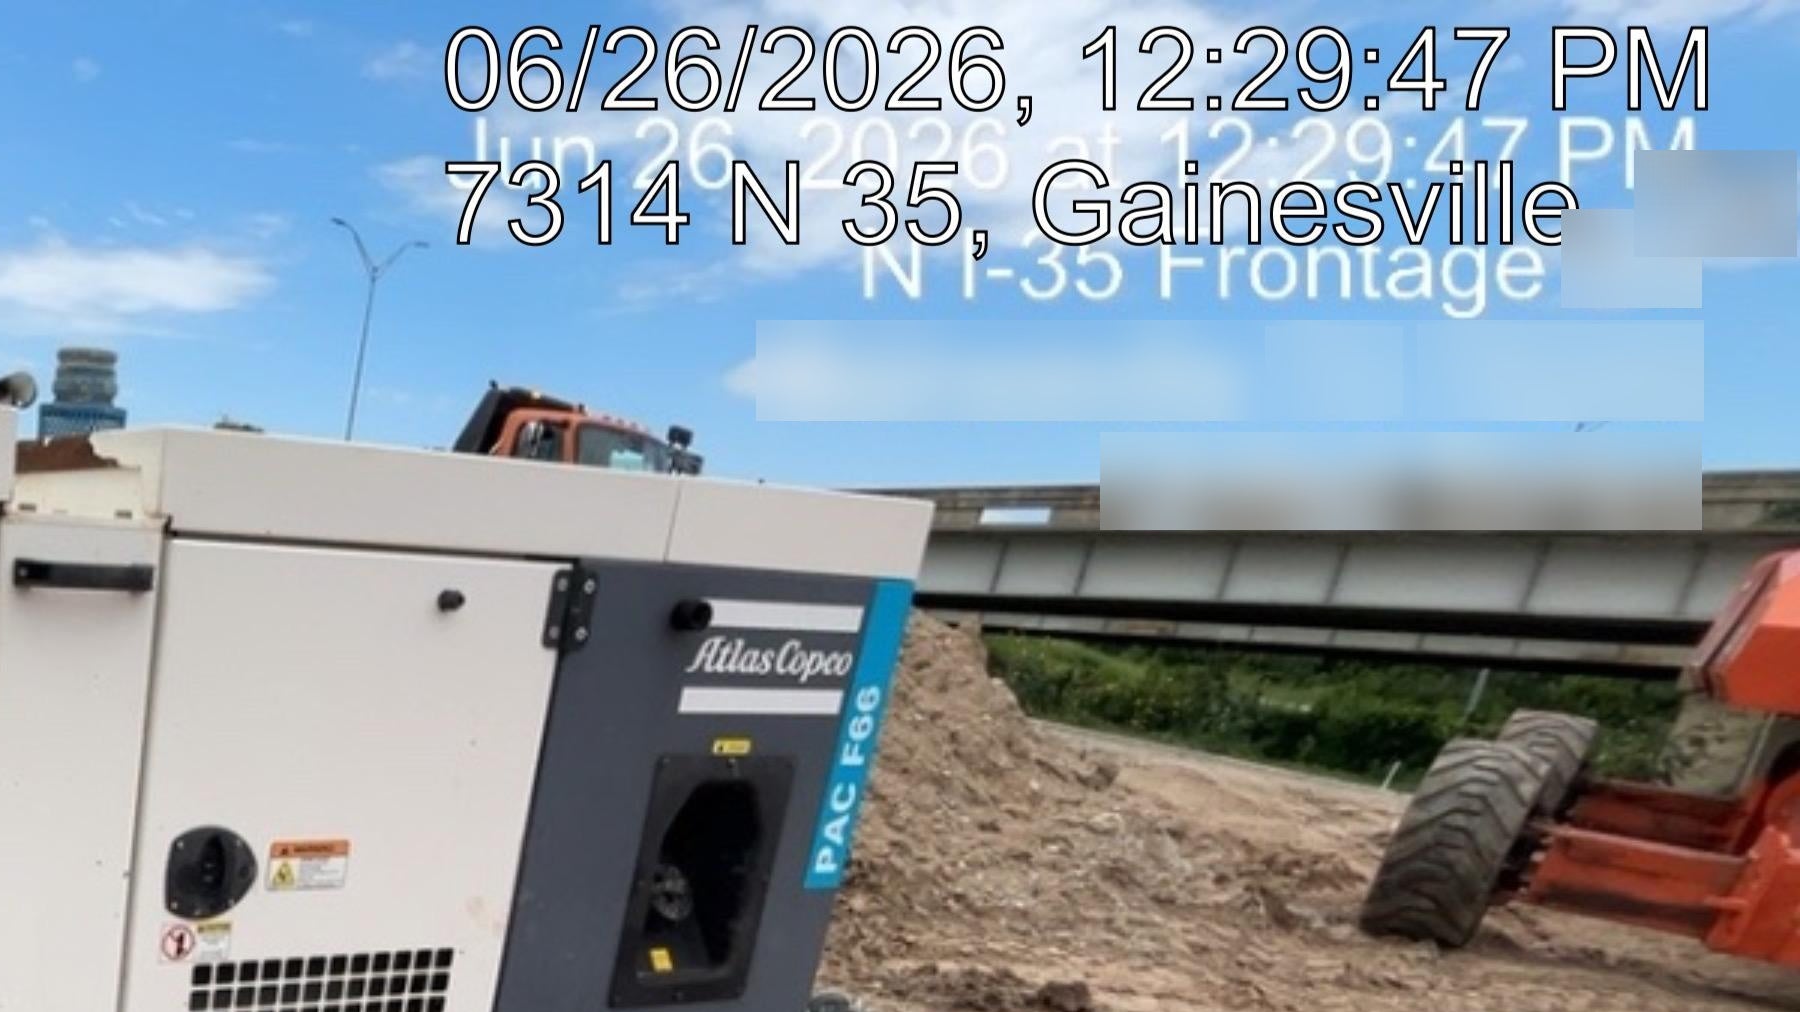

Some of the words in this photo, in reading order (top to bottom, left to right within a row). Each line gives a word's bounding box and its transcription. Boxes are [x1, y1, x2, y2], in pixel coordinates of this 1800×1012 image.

[685, 635, 776, 674] Atlas
[776, 638, 853, 684] Copco
[814, 784, 856, 874] PAC
[840, 685, 881, 766] F66
